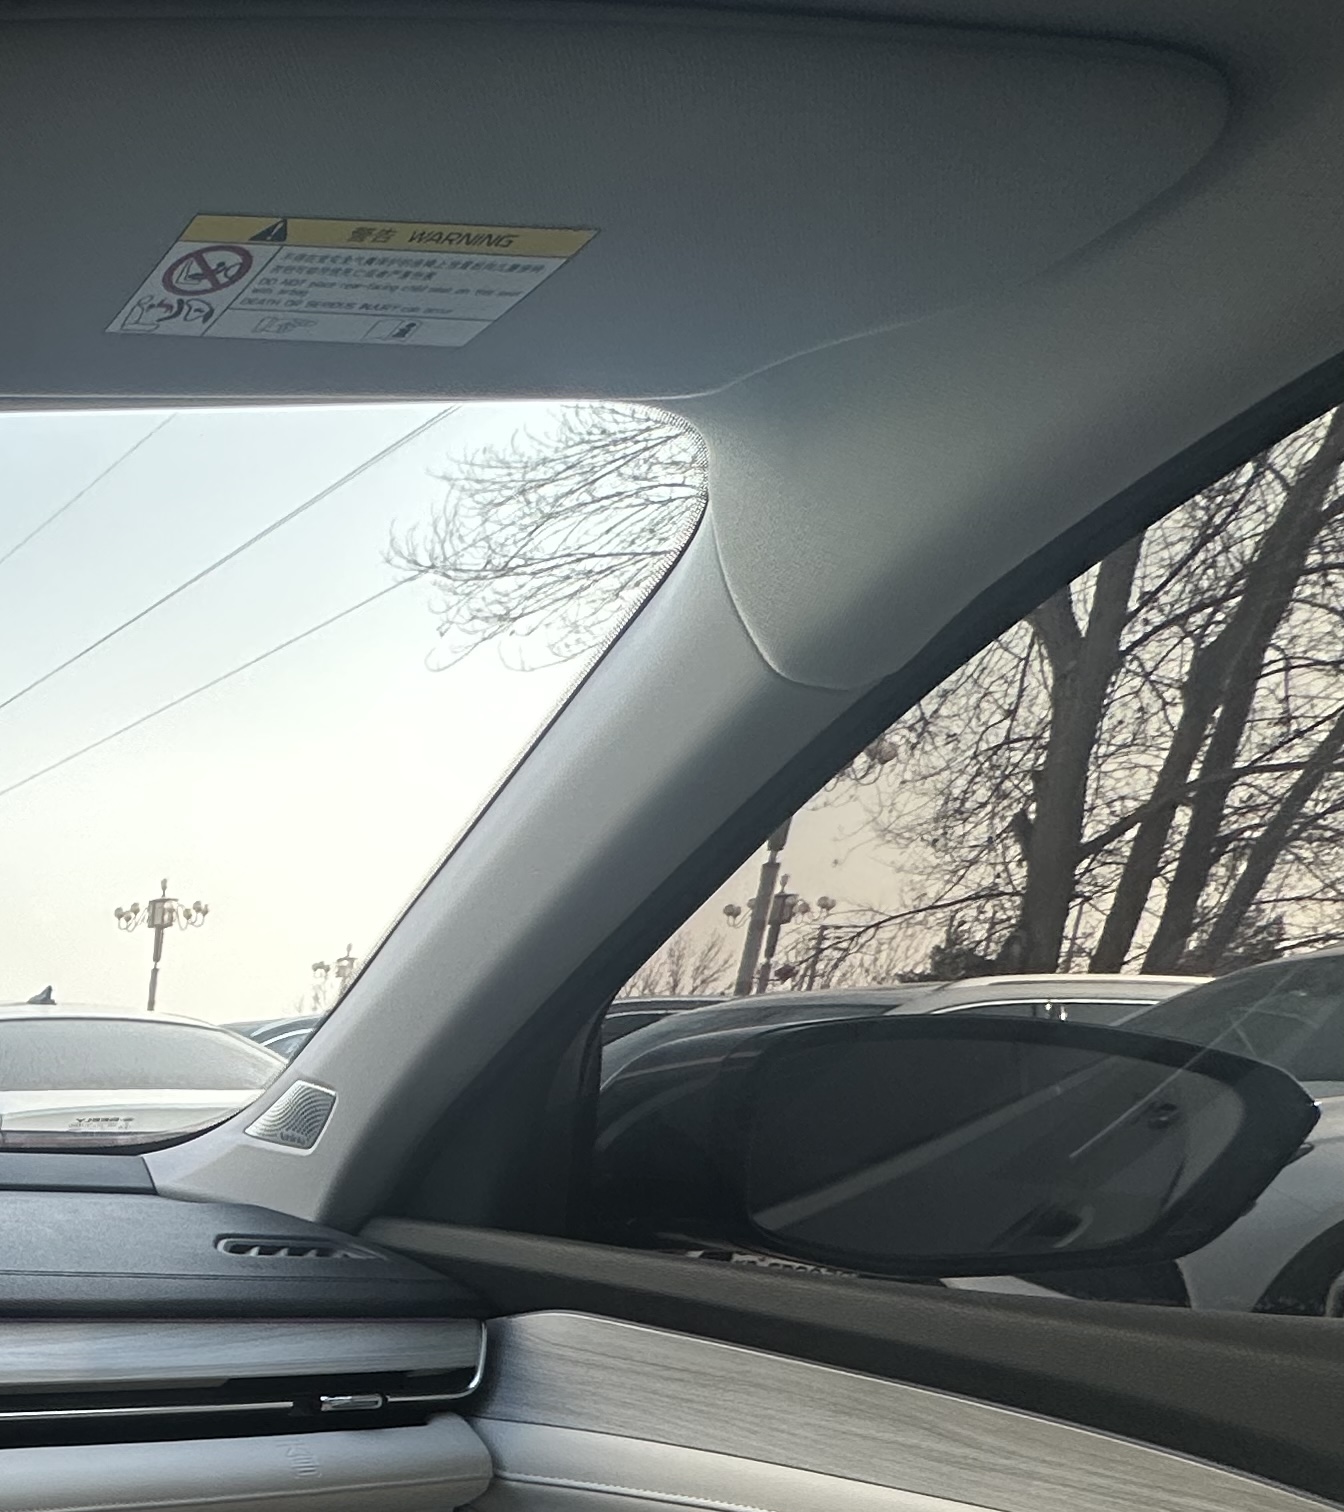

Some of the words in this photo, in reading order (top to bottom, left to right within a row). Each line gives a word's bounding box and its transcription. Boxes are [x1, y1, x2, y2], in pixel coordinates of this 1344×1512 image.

[348, 227, 397, 243] 警告
[408, 230, 519, 248] WARNING
[280, 279, 307, 287] NOT
[240, 298, 281, 306] DEATH
